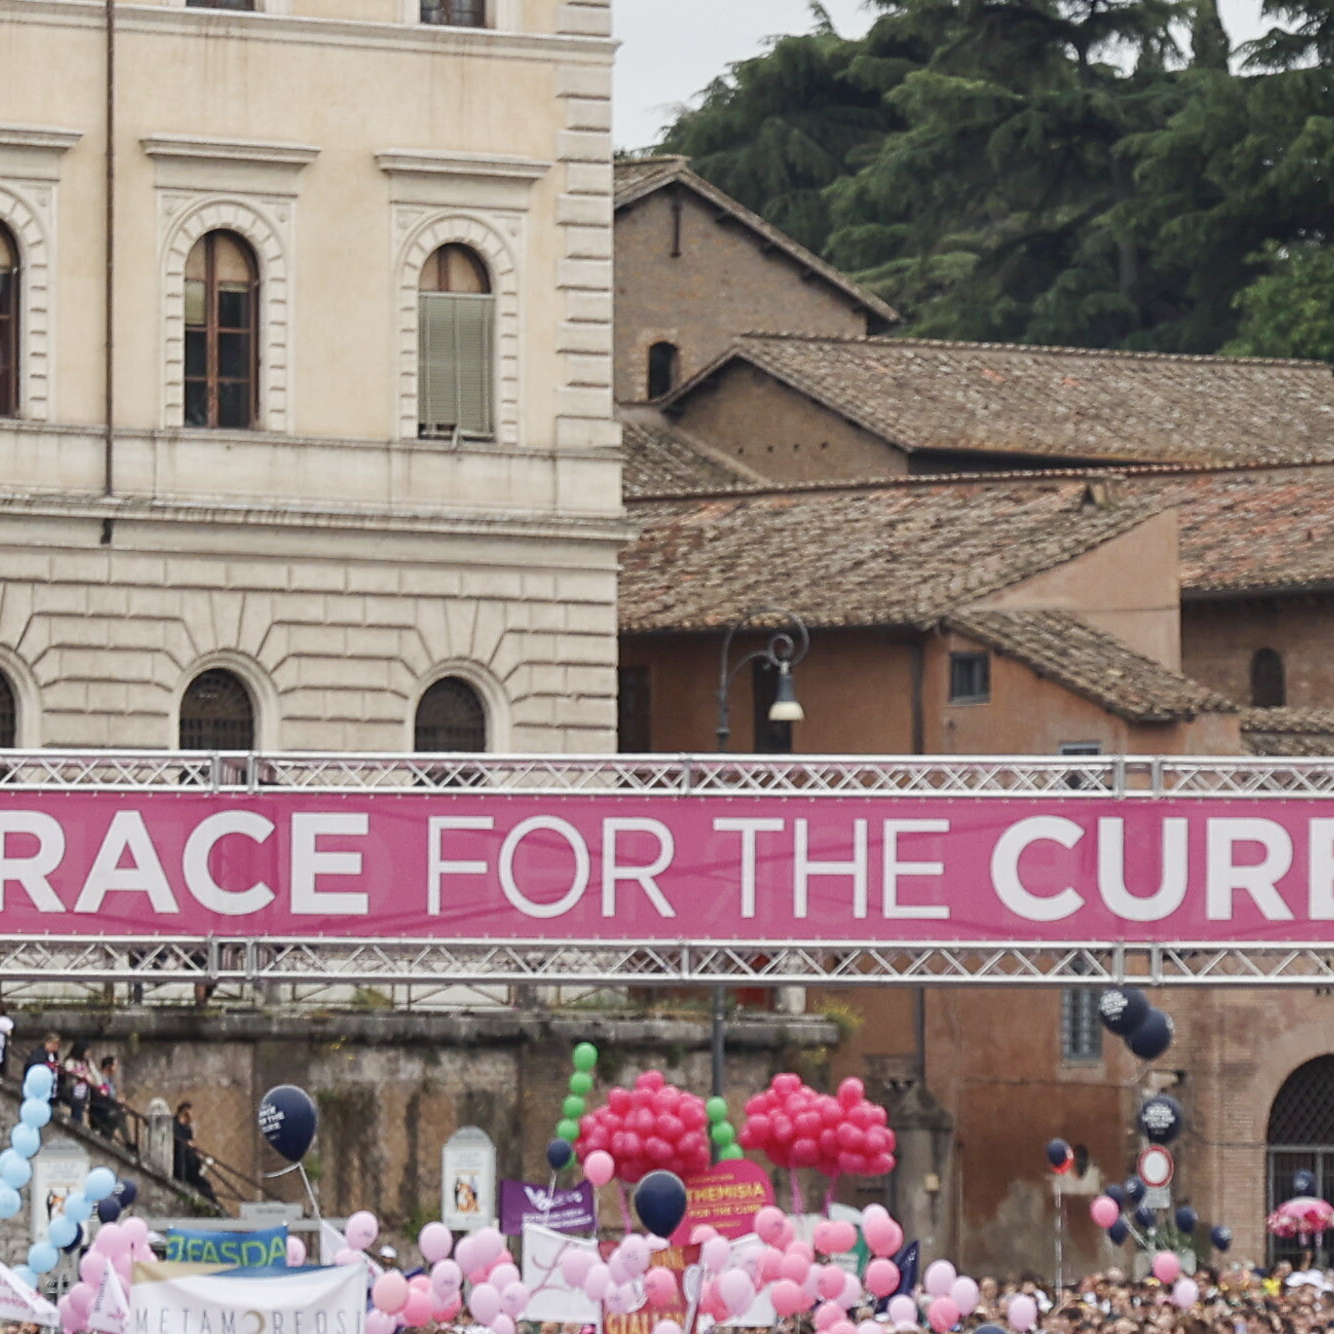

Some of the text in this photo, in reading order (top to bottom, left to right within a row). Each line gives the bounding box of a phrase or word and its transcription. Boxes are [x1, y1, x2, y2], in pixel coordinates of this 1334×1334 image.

[426, 814, 677, 918] FOR
[712, 817, 950, 919] THE
[187, 1236, 286, 1268] FASDA
